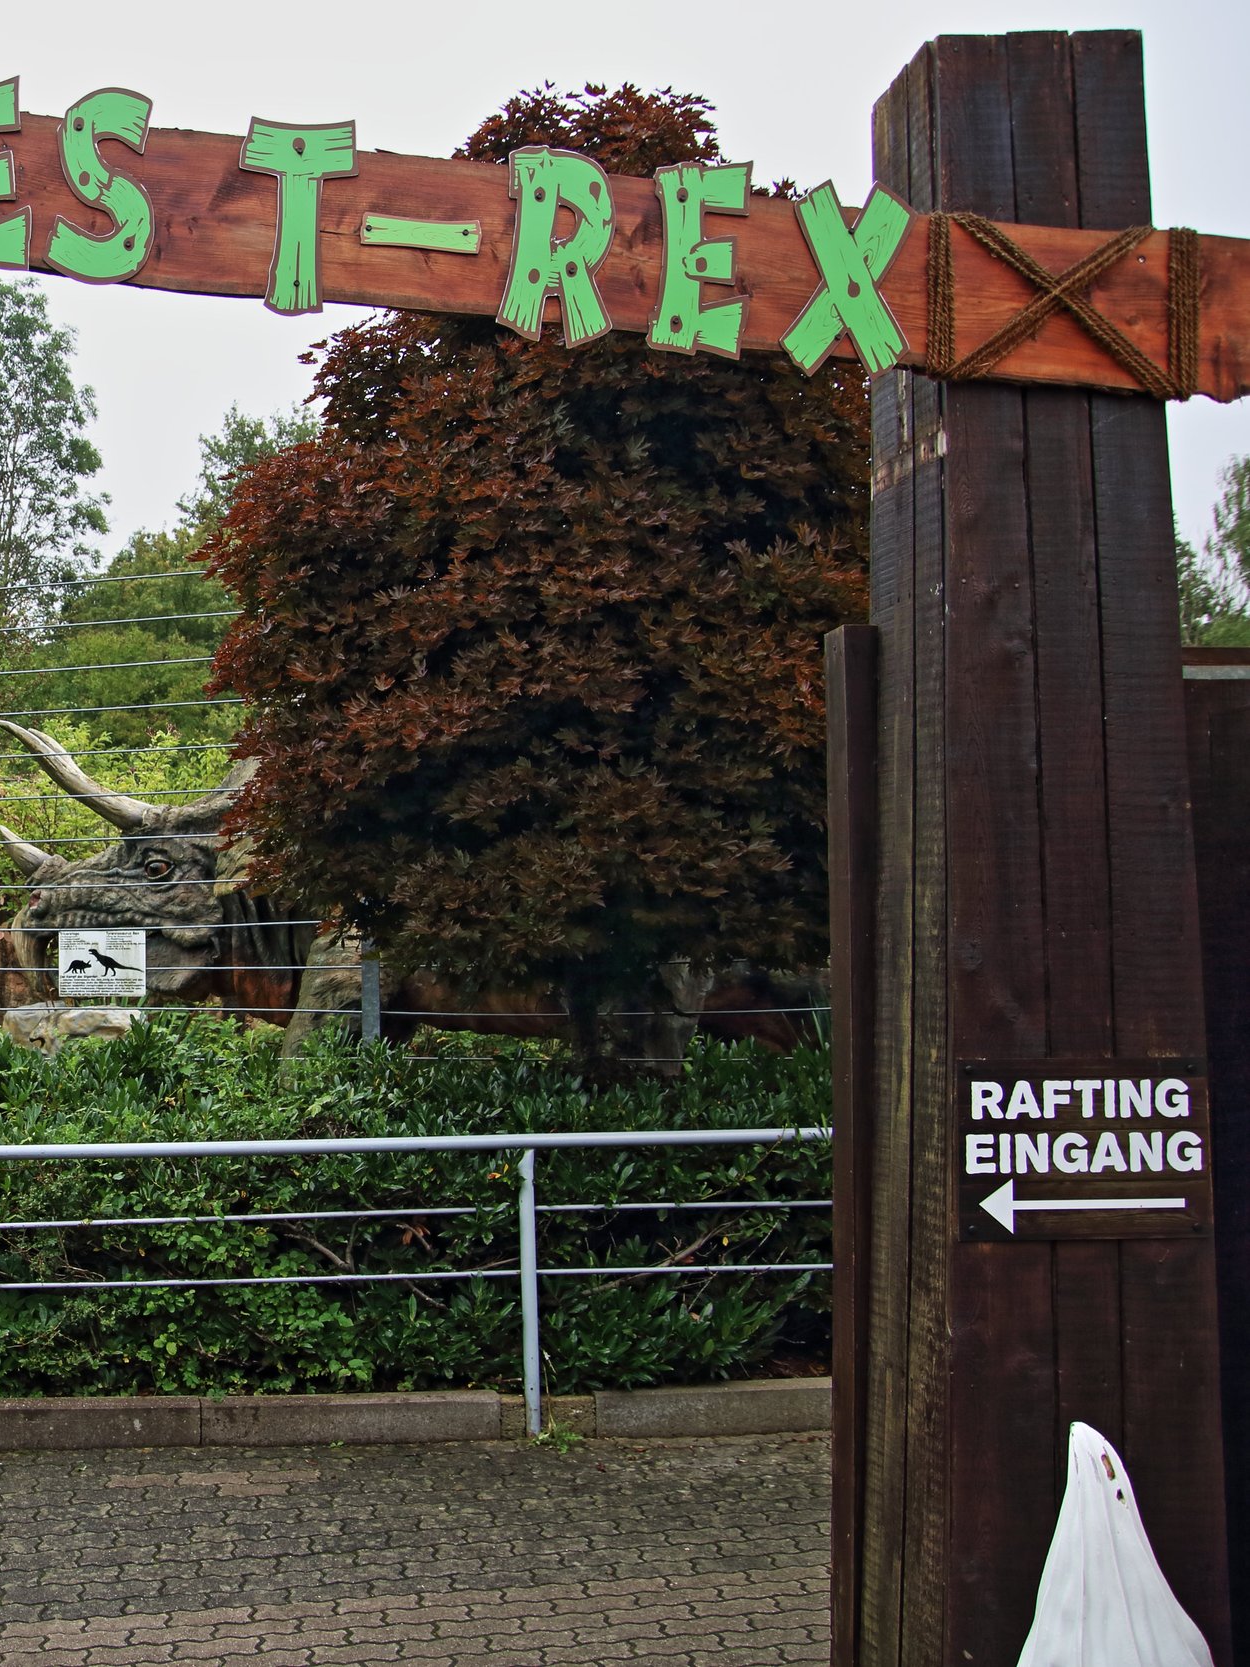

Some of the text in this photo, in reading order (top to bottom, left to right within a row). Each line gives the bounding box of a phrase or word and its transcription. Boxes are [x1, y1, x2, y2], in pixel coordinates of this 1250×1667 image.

[239, 116, 918, 379] T-REX
[970, 1078, 1190, 1120] RAFTING
[965, 1130, 1203, 1175] EINGANG
